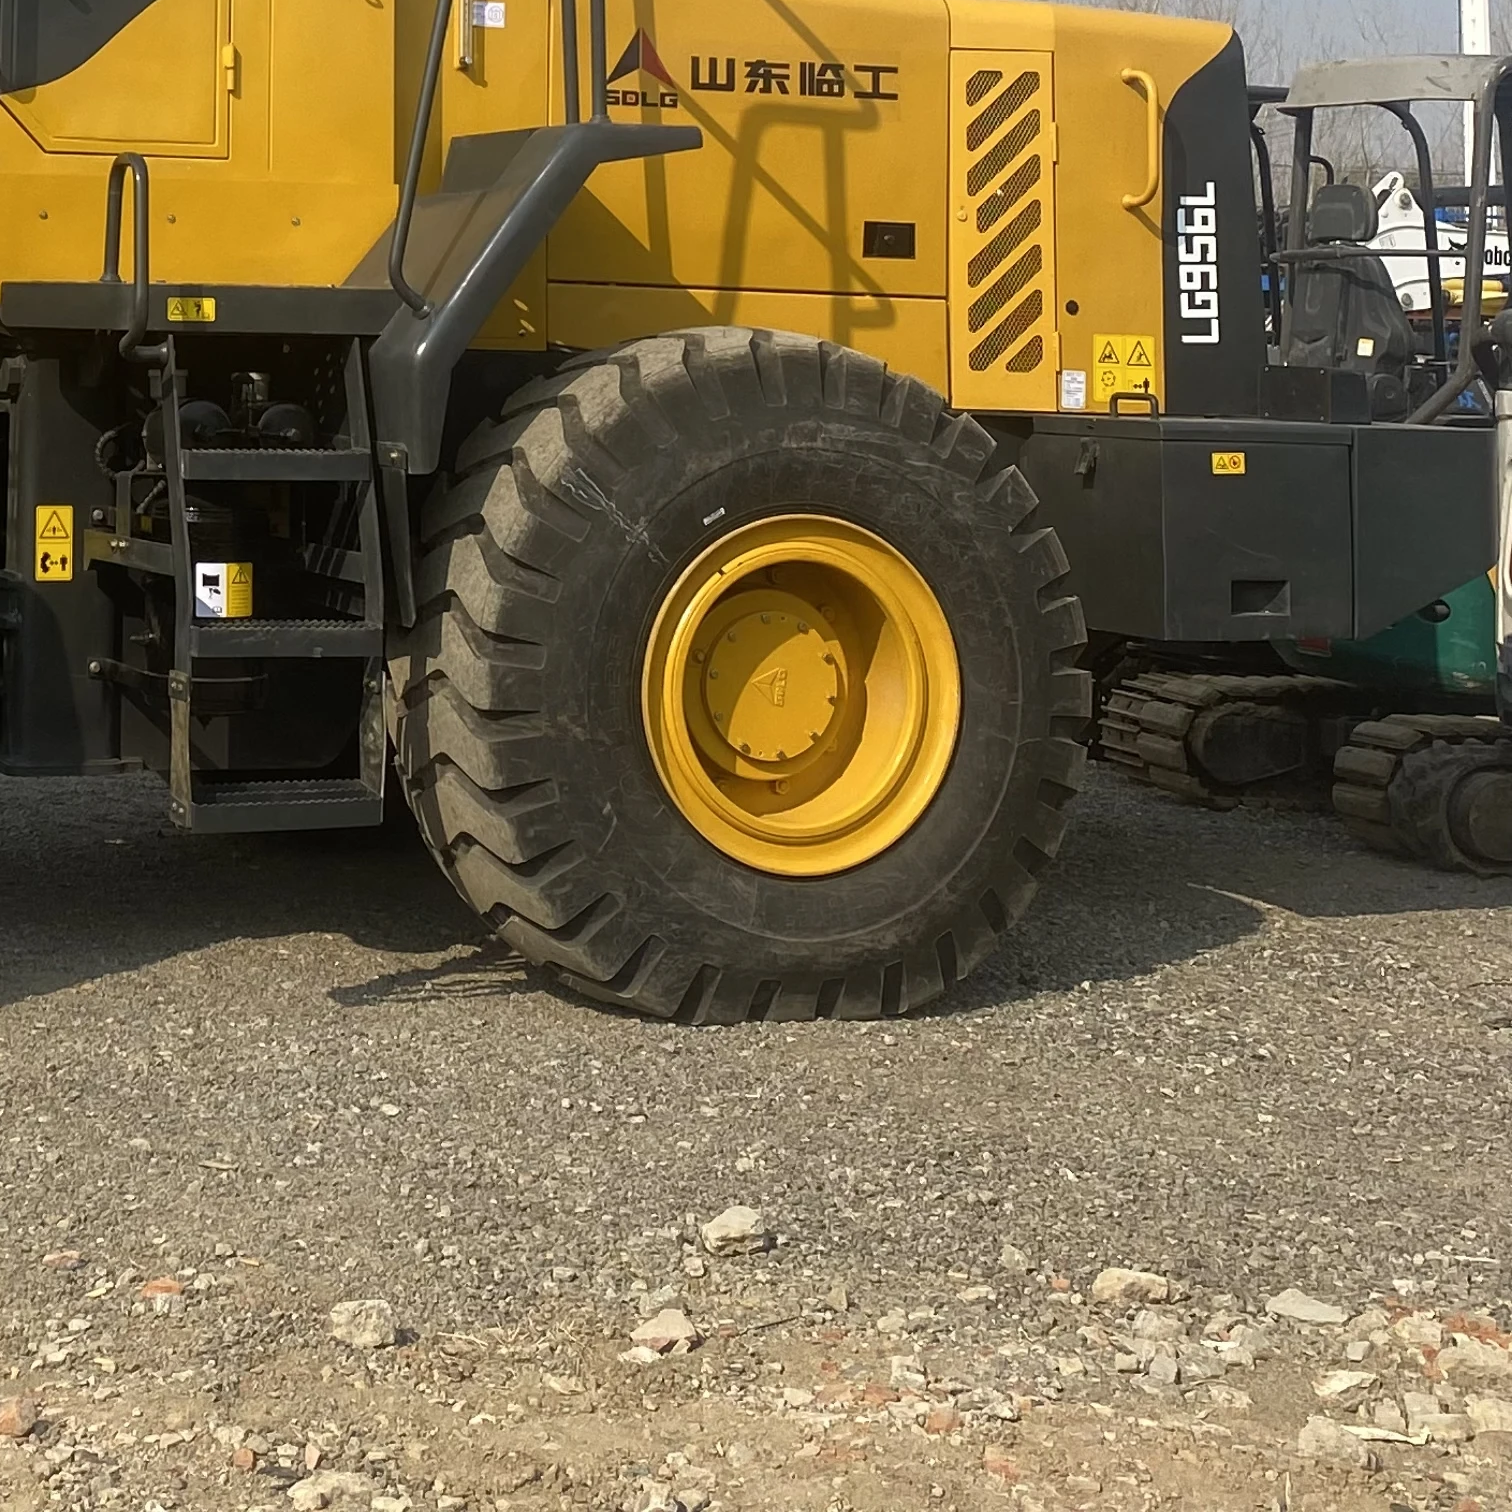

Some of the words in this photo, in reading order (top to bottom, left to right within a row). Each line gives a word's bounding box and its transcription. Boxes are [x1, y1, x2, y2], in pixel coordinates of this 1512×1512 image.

[690, 55, 898, 101] 山东临工
[606, 90, 678, 109] SDLG
[1177, 181, 1219, 345] LG956L
[1484, 245, 1511, 266] obc
